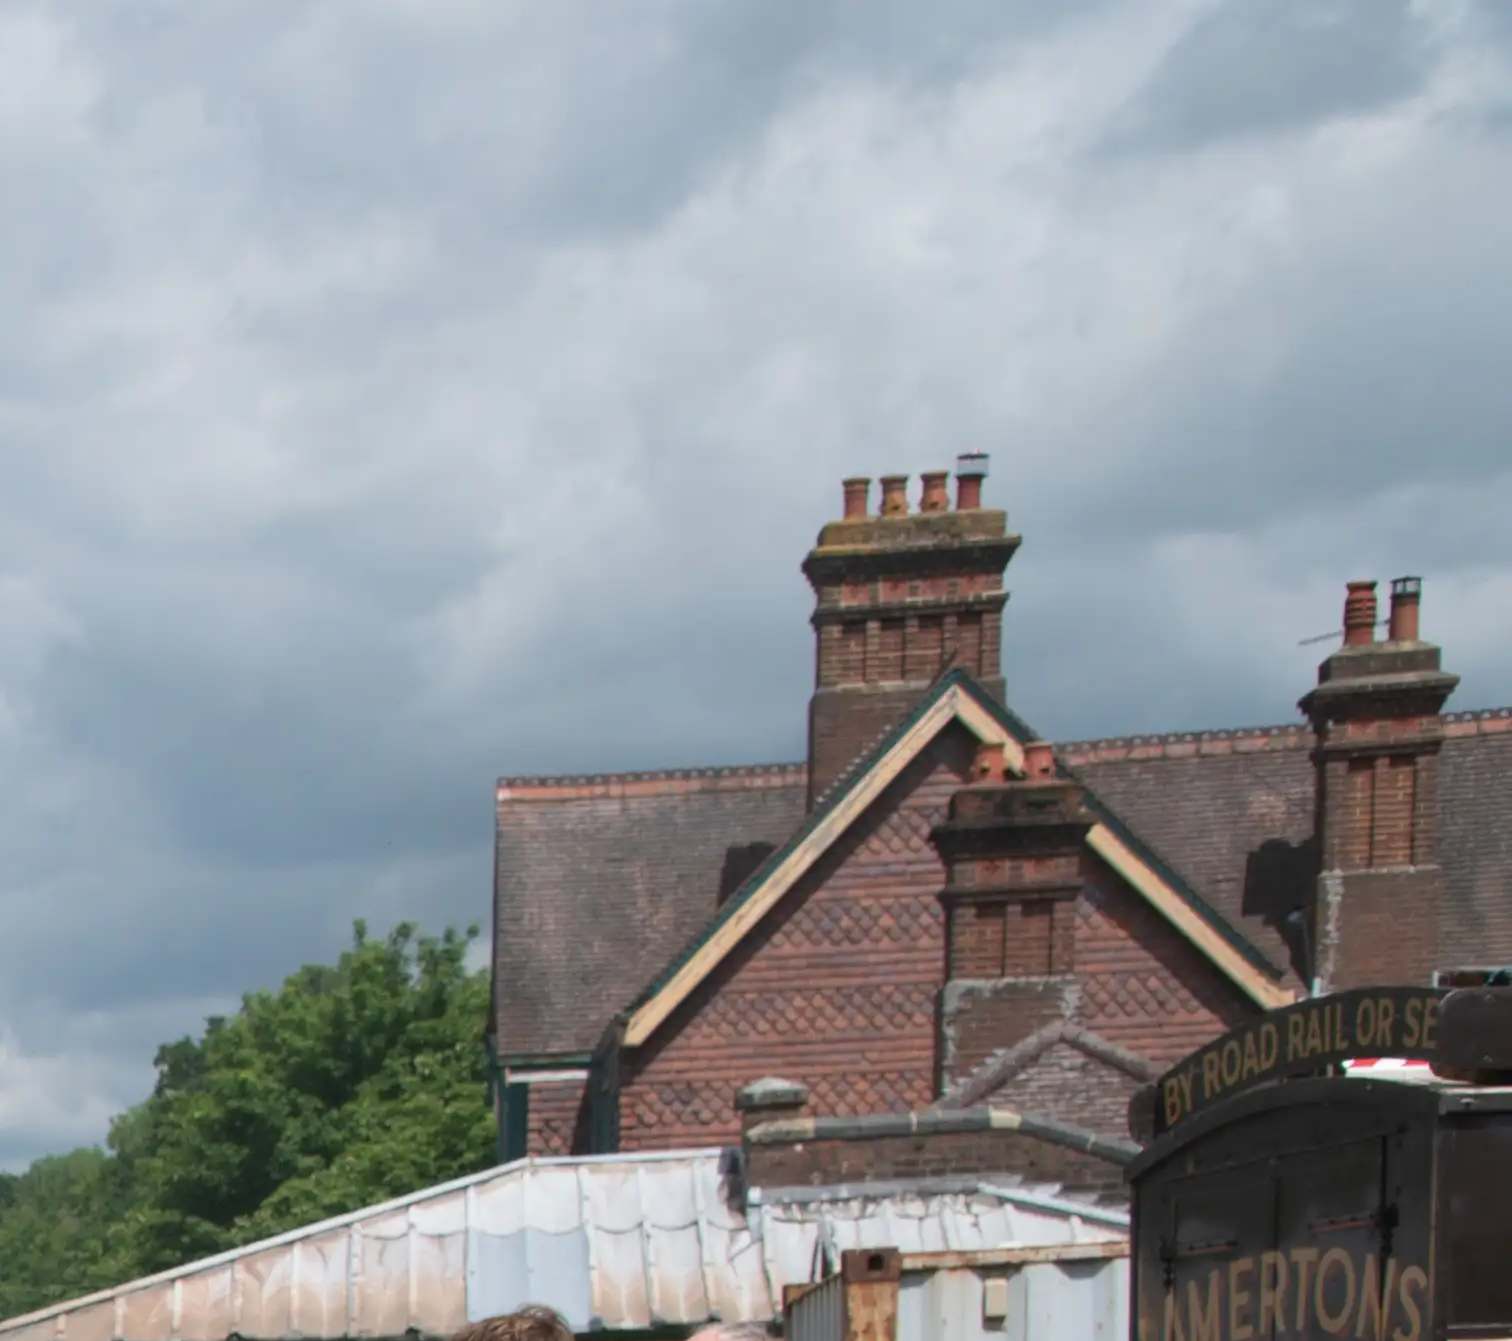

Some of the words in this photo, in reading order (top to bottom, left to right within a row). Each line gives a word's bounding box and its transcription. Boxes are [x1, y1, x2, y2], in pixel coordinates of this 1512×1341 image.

[1163, 1073, 1197, 1126] BY
[1203, 1022, 1279, 1099] ROAD
[1287, 1003, 1349, 1062] RAIL
[1356, 997, 1395, 1048] OR
[1402, 996, 1440, 1050] SE
